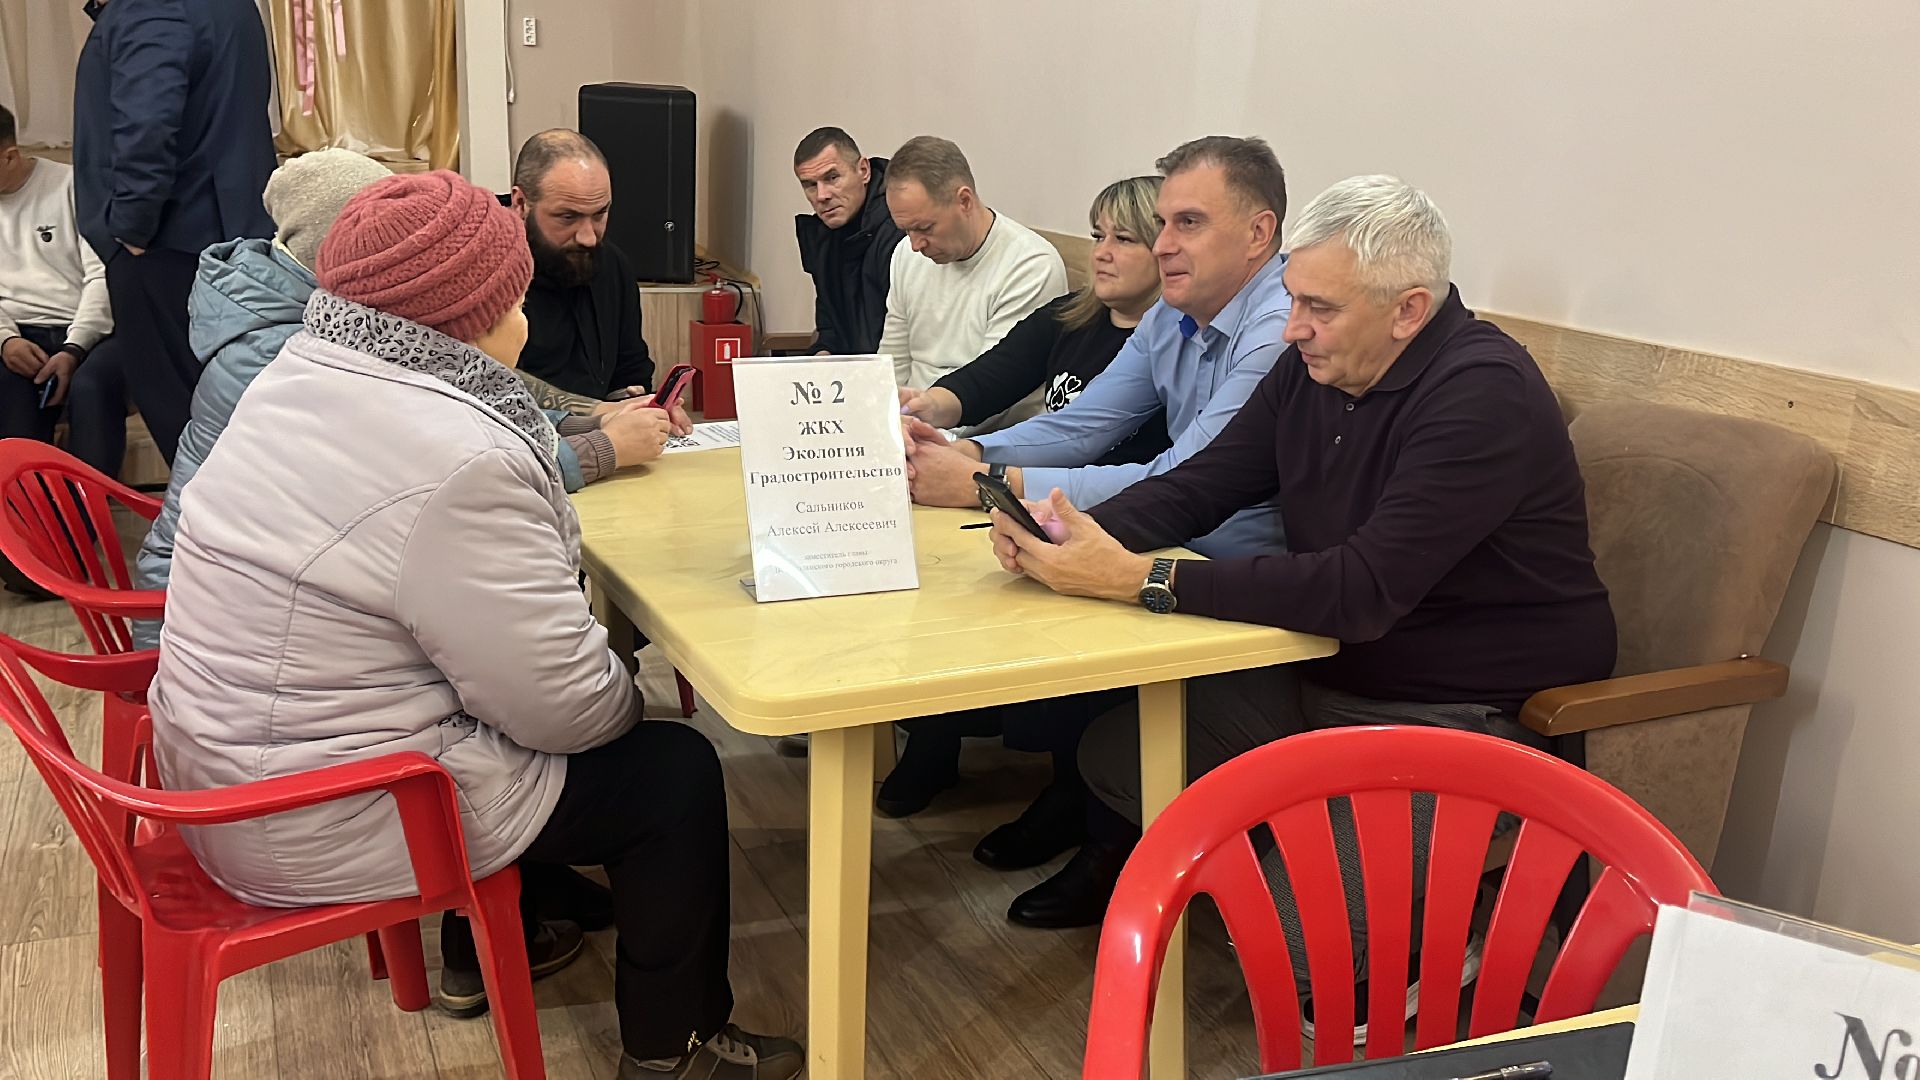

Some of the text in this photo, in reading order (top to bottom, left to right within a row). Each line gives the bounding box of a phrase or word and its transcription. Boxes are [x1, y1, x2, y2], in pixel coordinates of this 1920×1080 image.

[791, 380, 845, 405] № 2
[798, 420, 845, 435] ЖКХ
[782, 446, 865, 461] Экология
[750, 467, 901, 488] Градостроительство
[795, 500, 865, 514] Сальников
[767, 519, 897, 538] Алексей Алексеевич
